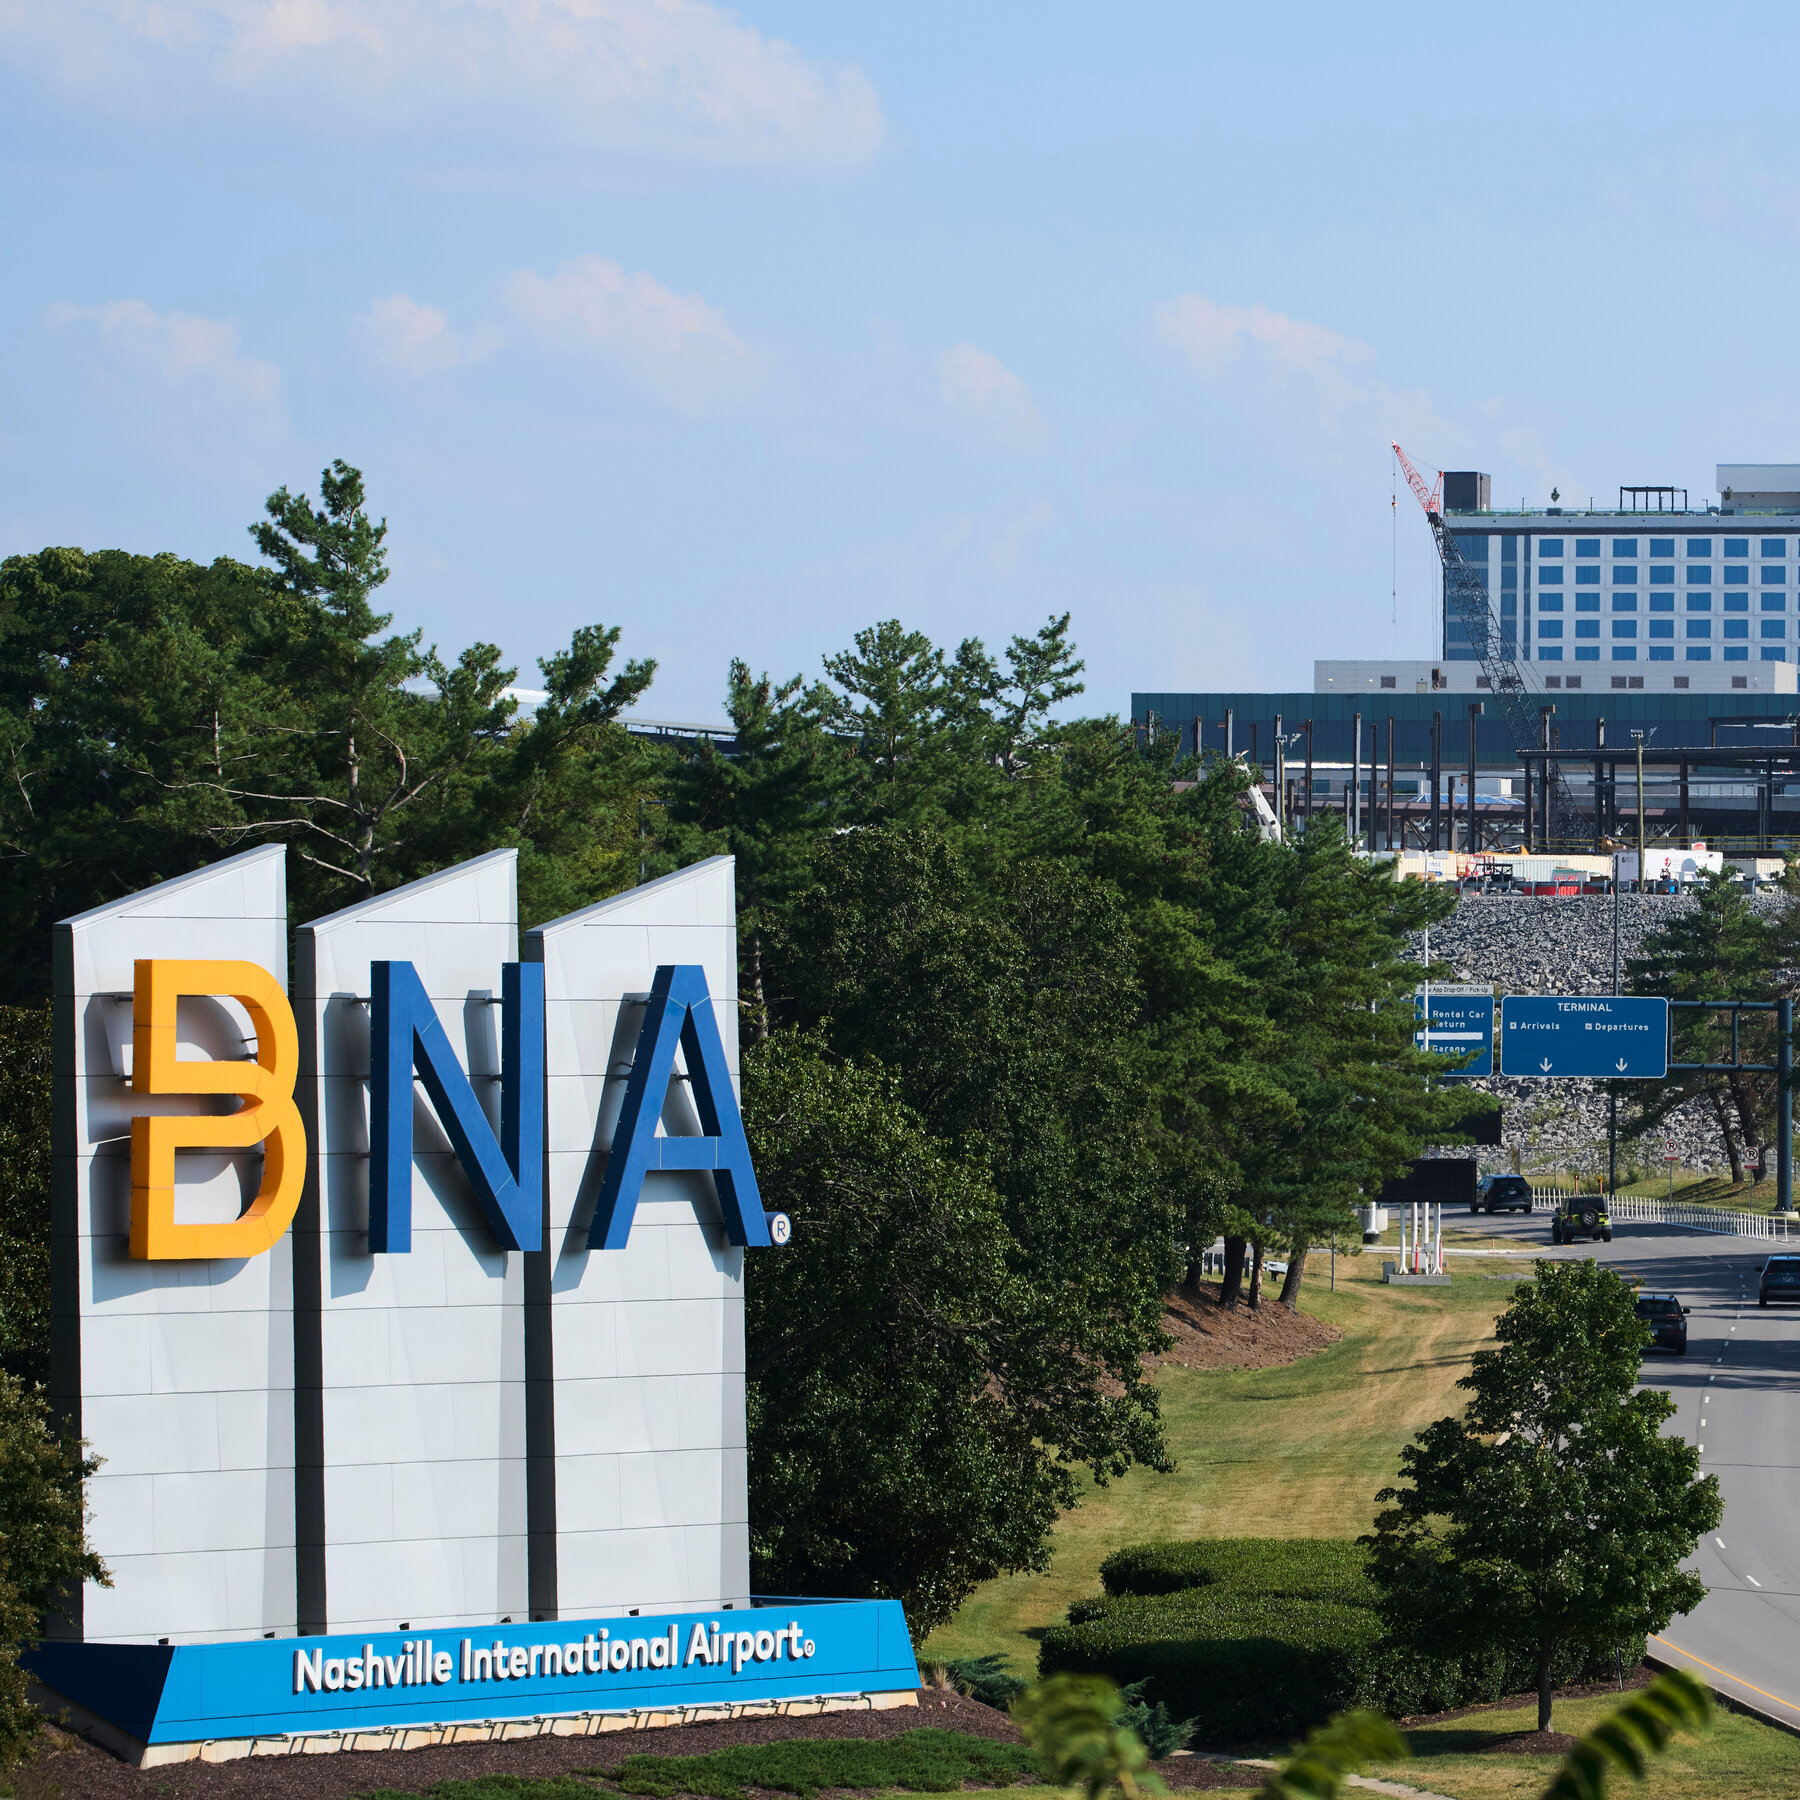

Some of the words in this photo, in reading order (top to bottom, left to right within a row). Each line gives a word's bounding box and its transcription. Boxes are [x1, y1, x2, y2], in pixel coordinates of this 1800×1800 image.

[1557, 1003, 1613, 1012] TERMINAL
[1432, 1010, 1464, 1018] Rental
[1468, 1010, 1485, 1018] Car
[1520, 1022, 1560, 1030] Arrivals
[1595, 1023, 1649, 1032] Departures
[129, 959, 772, 1261] BNA
[294, 1640, 453, 1692] Nashville
[460, 1624, 678, 1681] International
